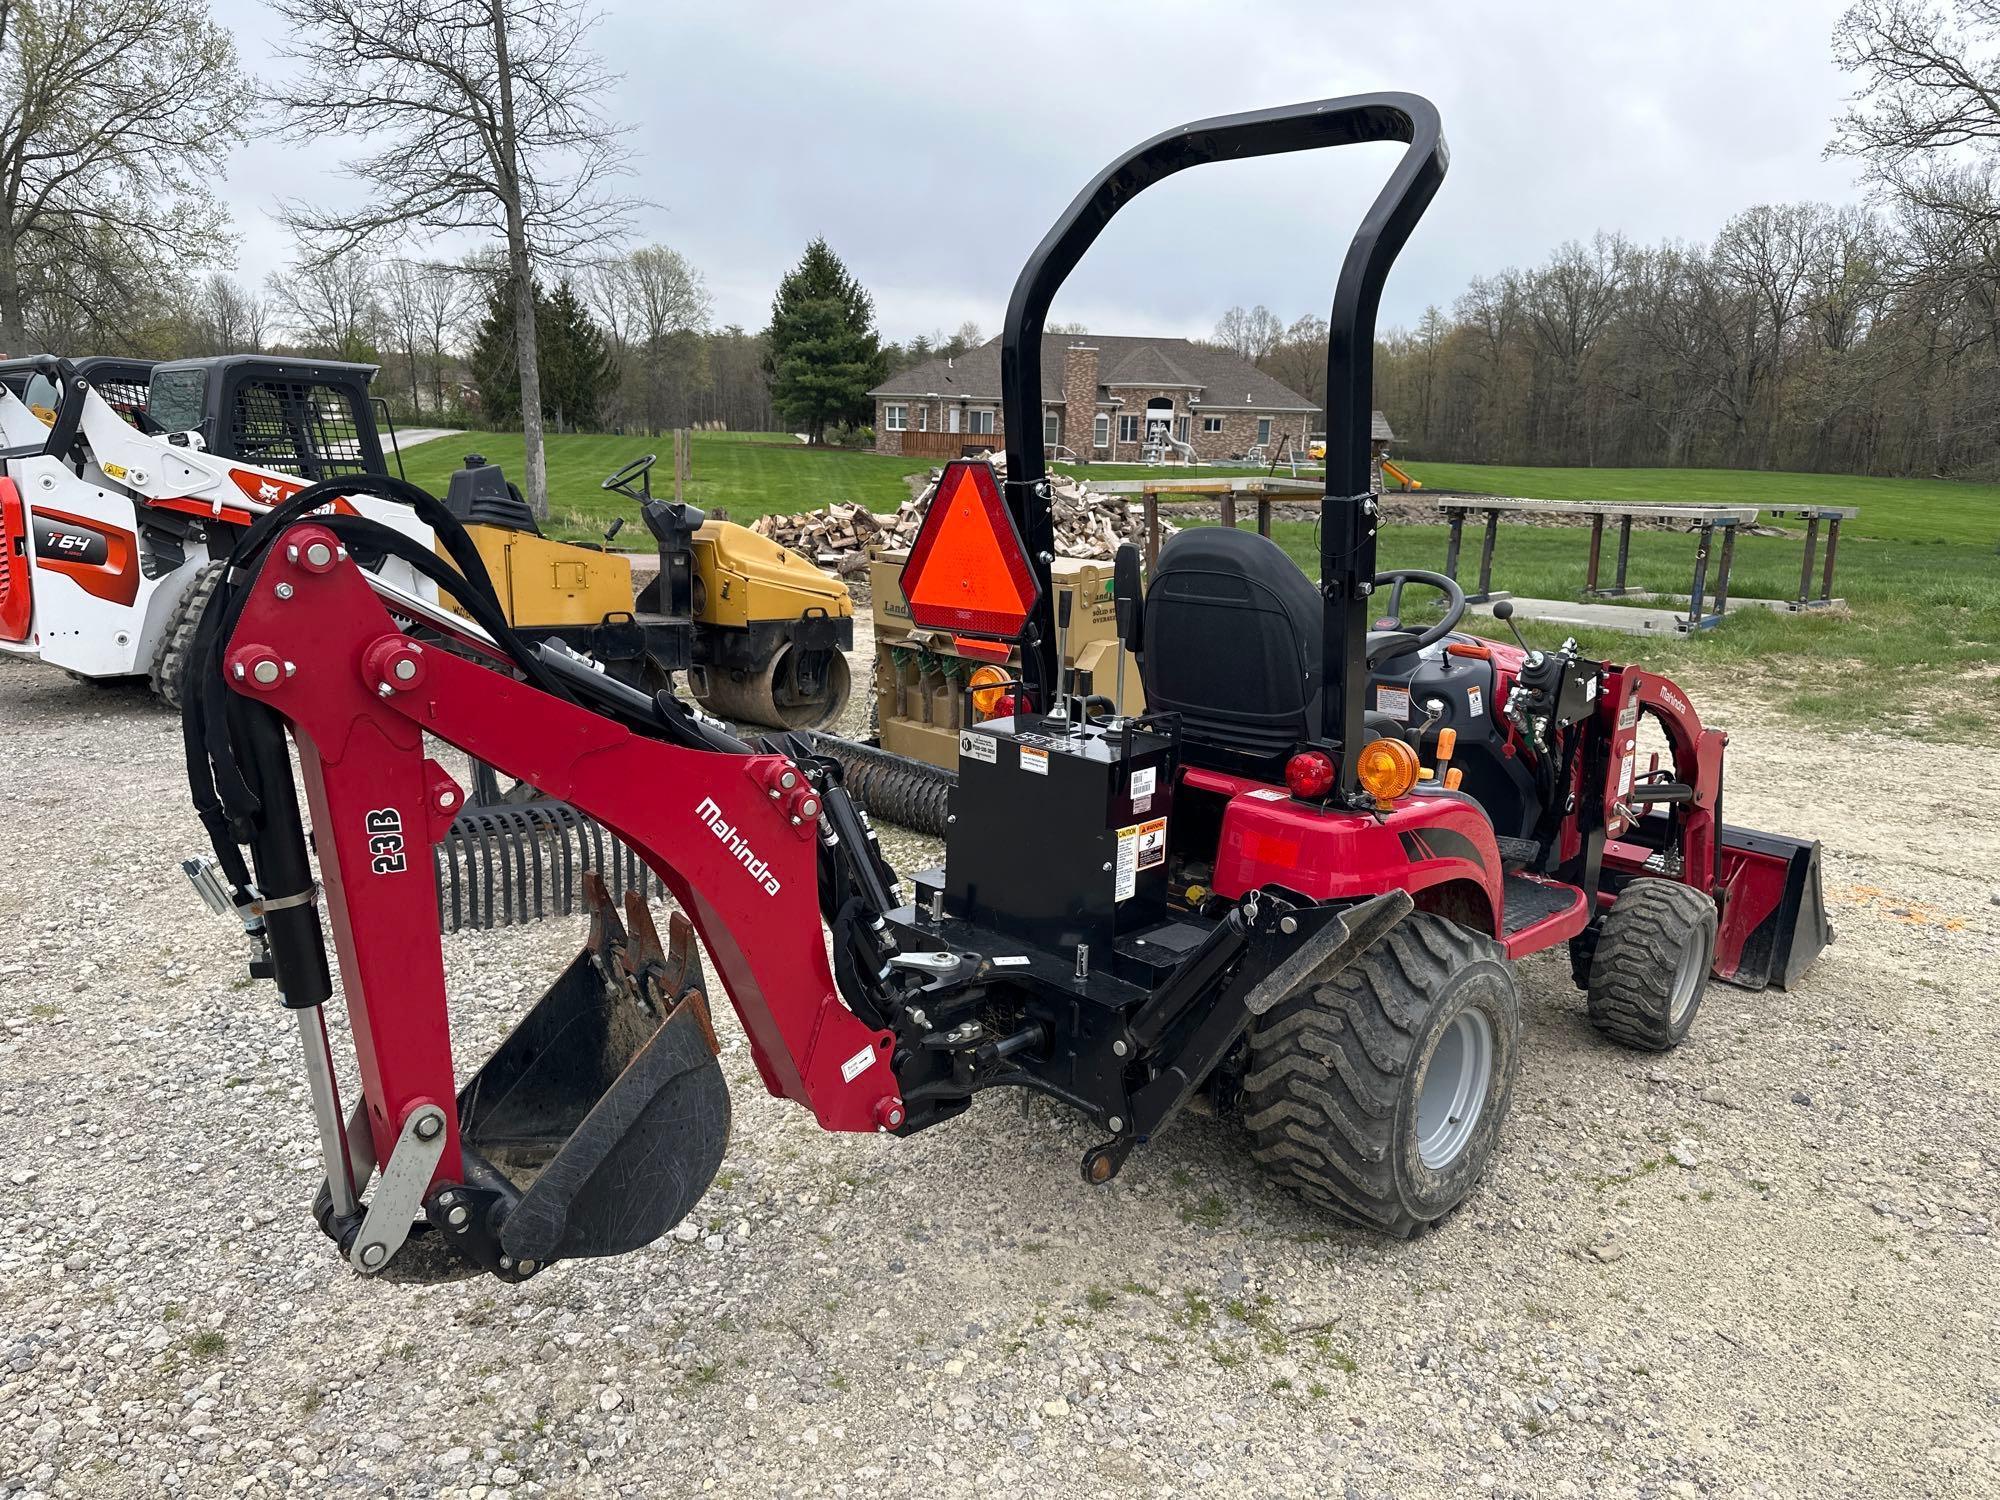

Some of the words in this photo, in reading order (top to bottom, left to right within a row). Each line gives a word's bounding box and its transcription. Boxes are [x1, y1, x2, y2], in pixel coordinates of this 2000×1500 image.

[47, 532, 92, 551] T64
[1092, 609, 1109, 617] SOLID
[1659, 685, 1687, 715] Mahindra
[365, 807, 408, 875] 23B
[694, 796, 781, 897] Mahindra
